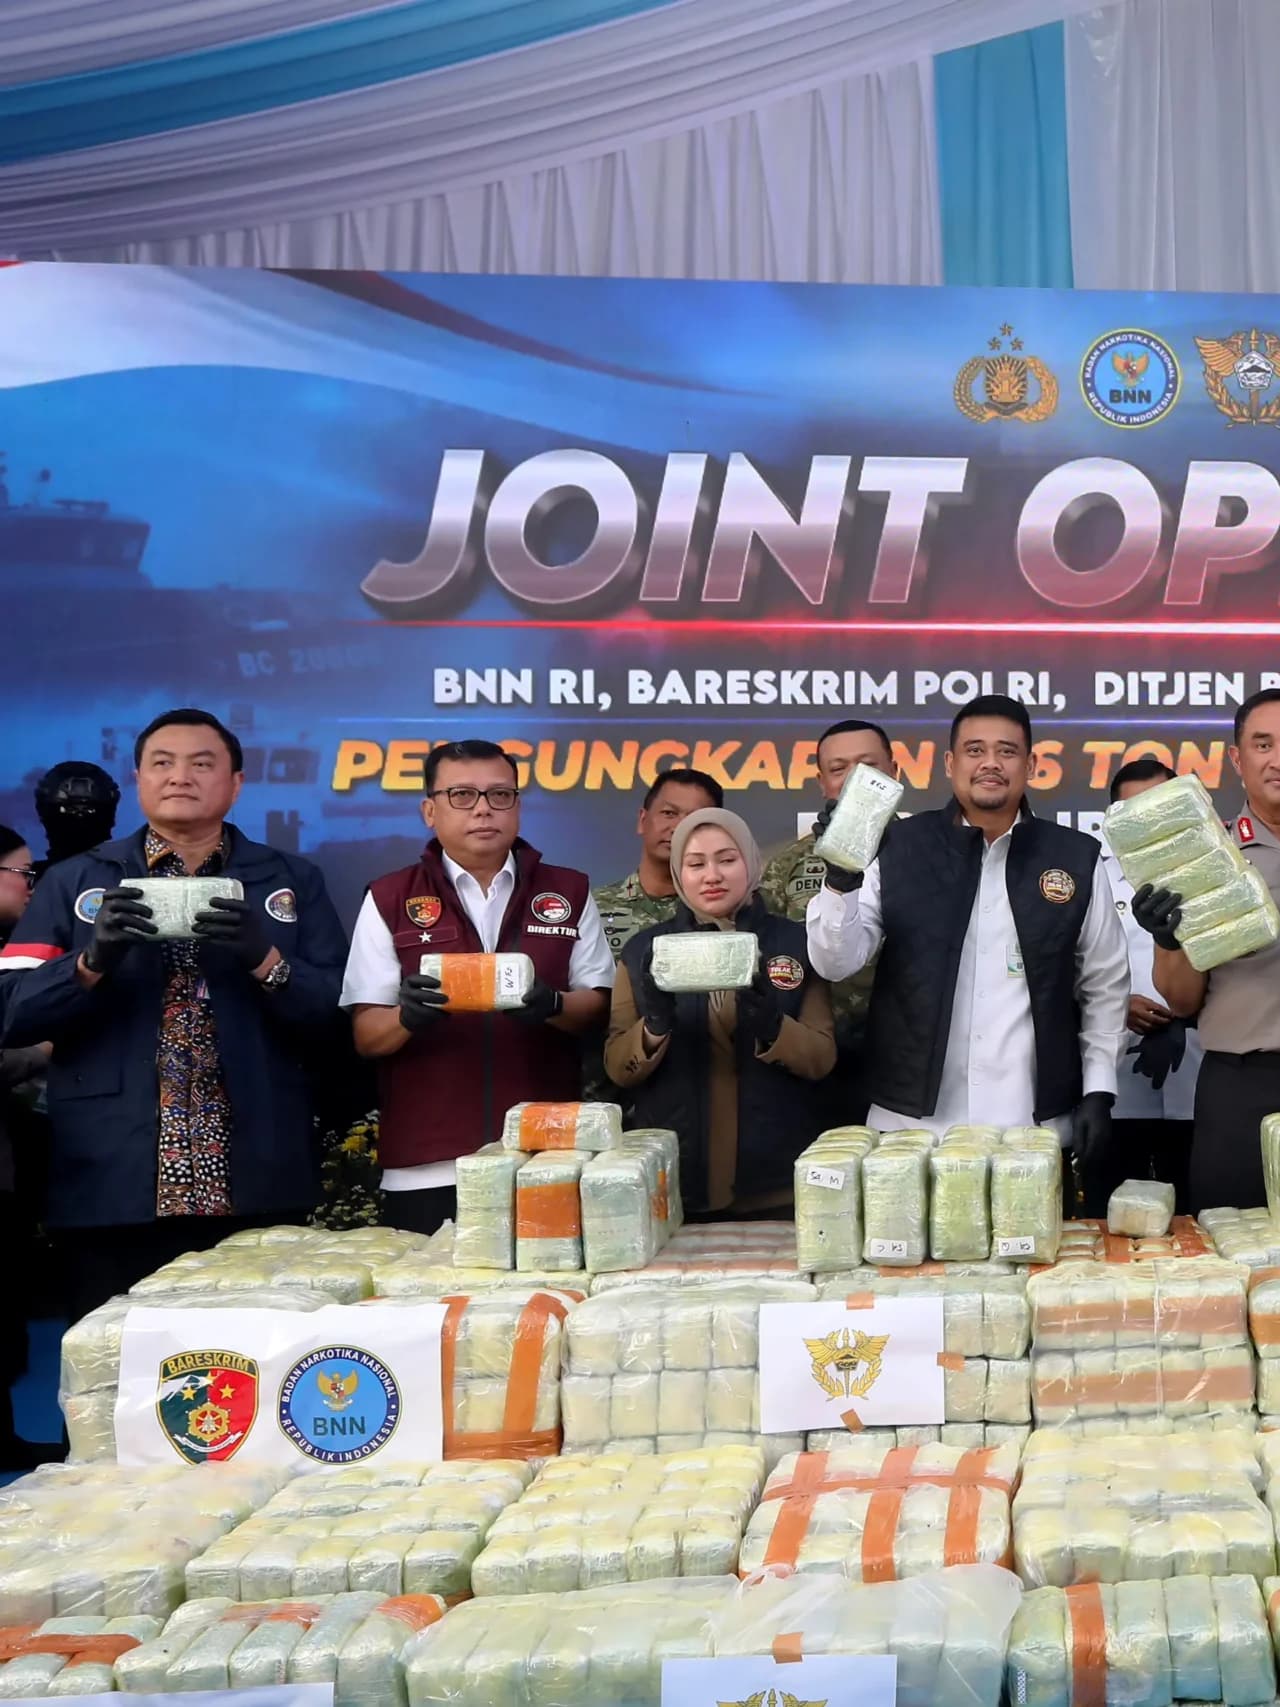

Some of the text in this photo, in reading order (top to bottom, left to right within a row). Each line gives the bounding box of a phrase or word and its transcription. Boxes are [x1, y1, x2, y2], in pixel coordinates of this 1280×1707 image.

[1088, 391, 1174, 423] REPUBLIK INDONESIA
[1108, 389, 1152, 404] BNN
[359, 448, 969, 606] JOINT
[433, 667, 533, 704] BNN
[549, 668, 612, 711] RI,
[628, 669, 898, 705] BARESKRIM
[1094, 671, 1245, 706] DITJEN
[526, 924, 578, 938] DIREKTUR
[167, 1353, 249, 1374] BARESKRIM
[281, 1348, 397, 1403] BADAN NARKOTIKA NASIONAL
[281, 1417, 335, 1462] REPUBLIK
[339, 1414, 397, 1462] INDONESIA
[312, 1415, 367, 1436] BNN
